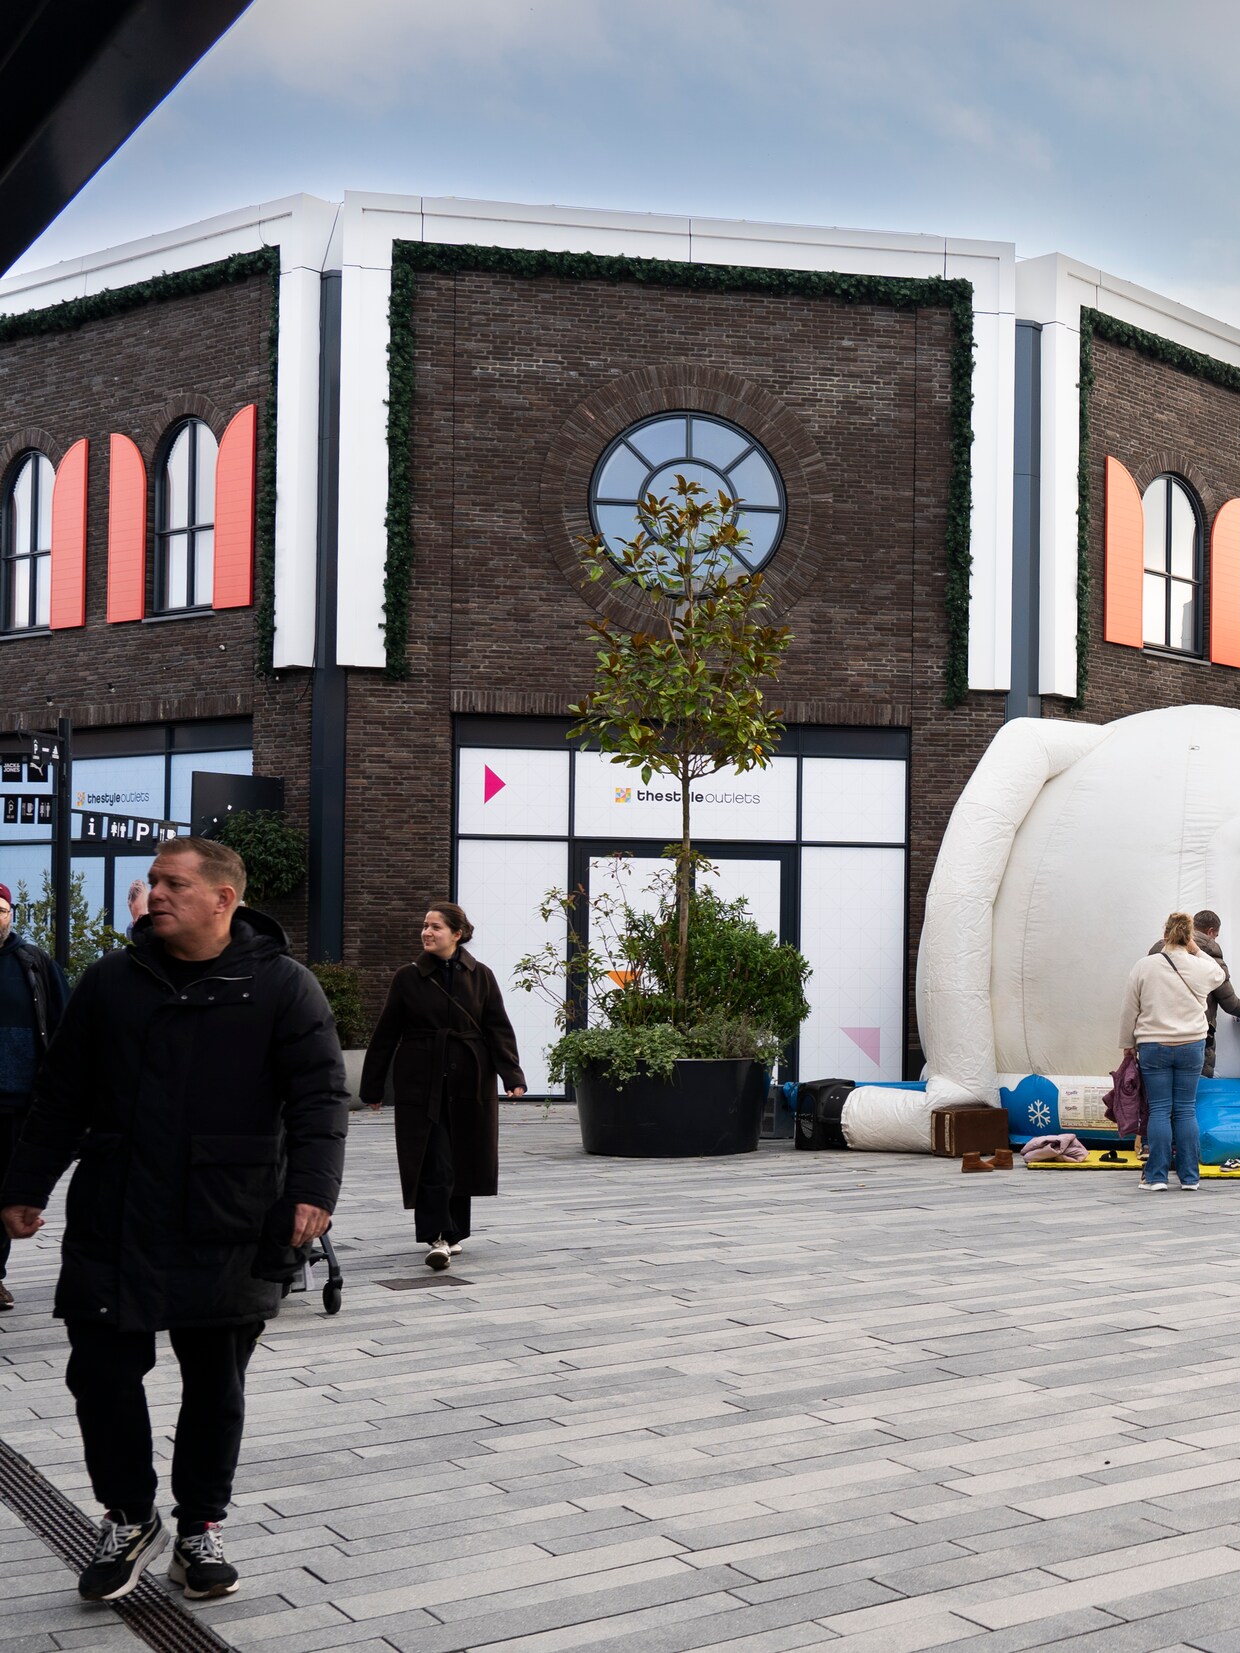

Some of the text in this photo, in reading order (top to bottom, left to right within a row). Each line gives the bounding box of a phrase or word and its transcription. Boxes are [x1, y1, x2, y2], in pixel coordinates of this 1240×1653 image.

[87, 791, 150, 807] thestyleoutlets
[637, 790, 761, 804] thestleoutlets
[135, 822, 150, 841] P
